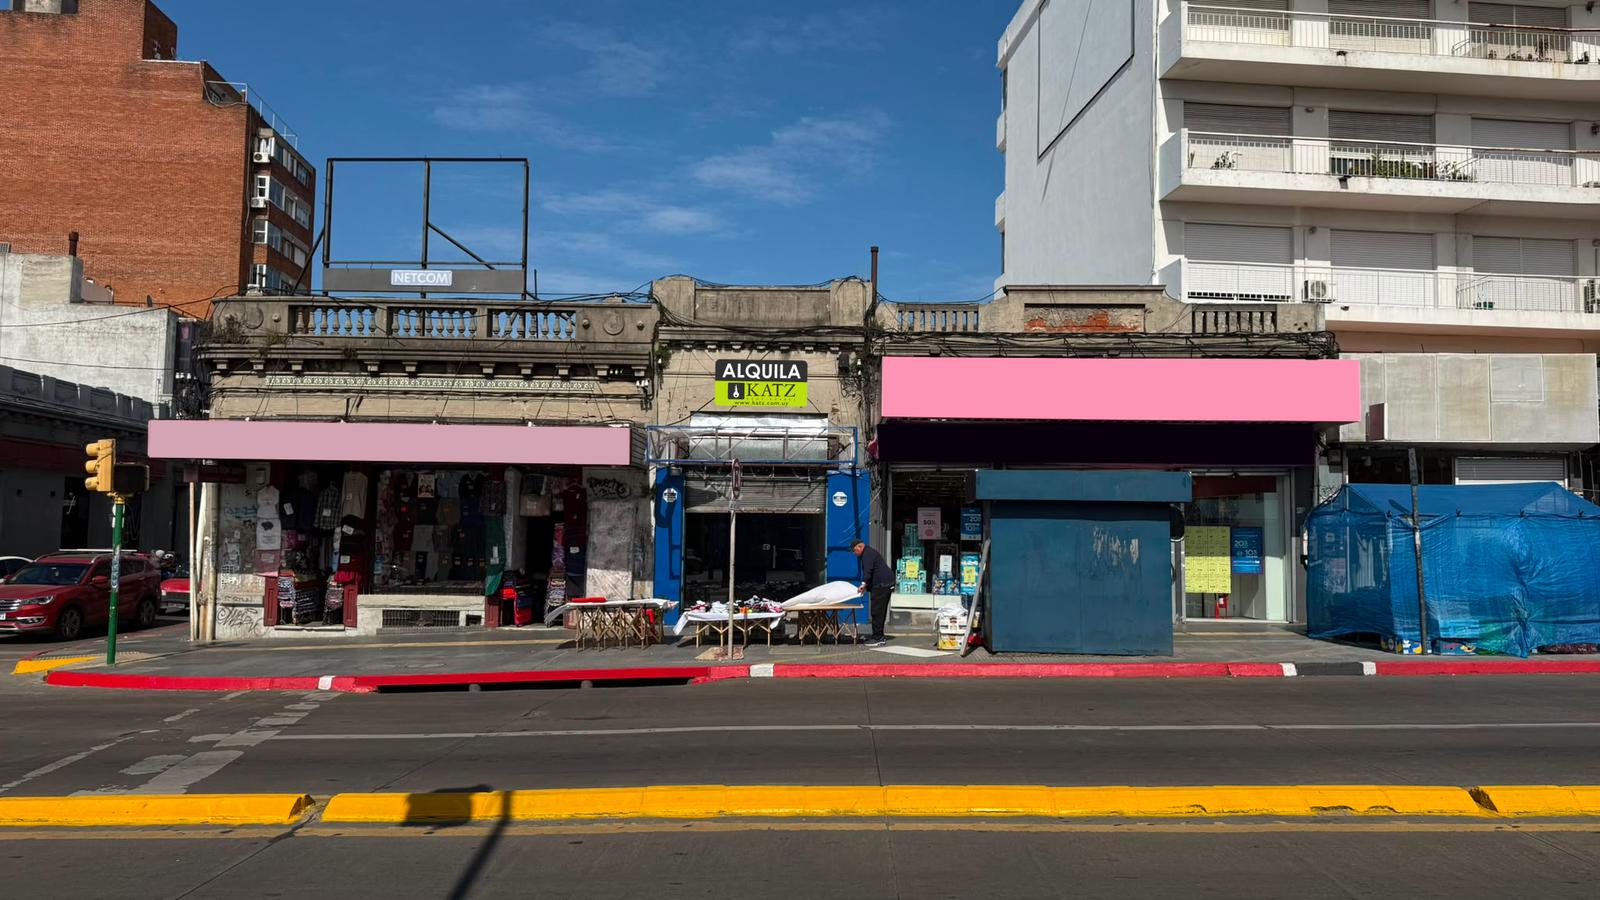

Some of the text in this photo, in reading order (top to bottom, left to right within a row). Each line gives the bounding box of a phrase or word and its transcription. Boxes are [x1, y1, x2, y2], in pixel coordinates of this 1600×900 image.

[394, 272, 449, 283] NETCOM
[722, 363, 801, 380] ALQUILA
[746, 383, 796, 397] KATZ
